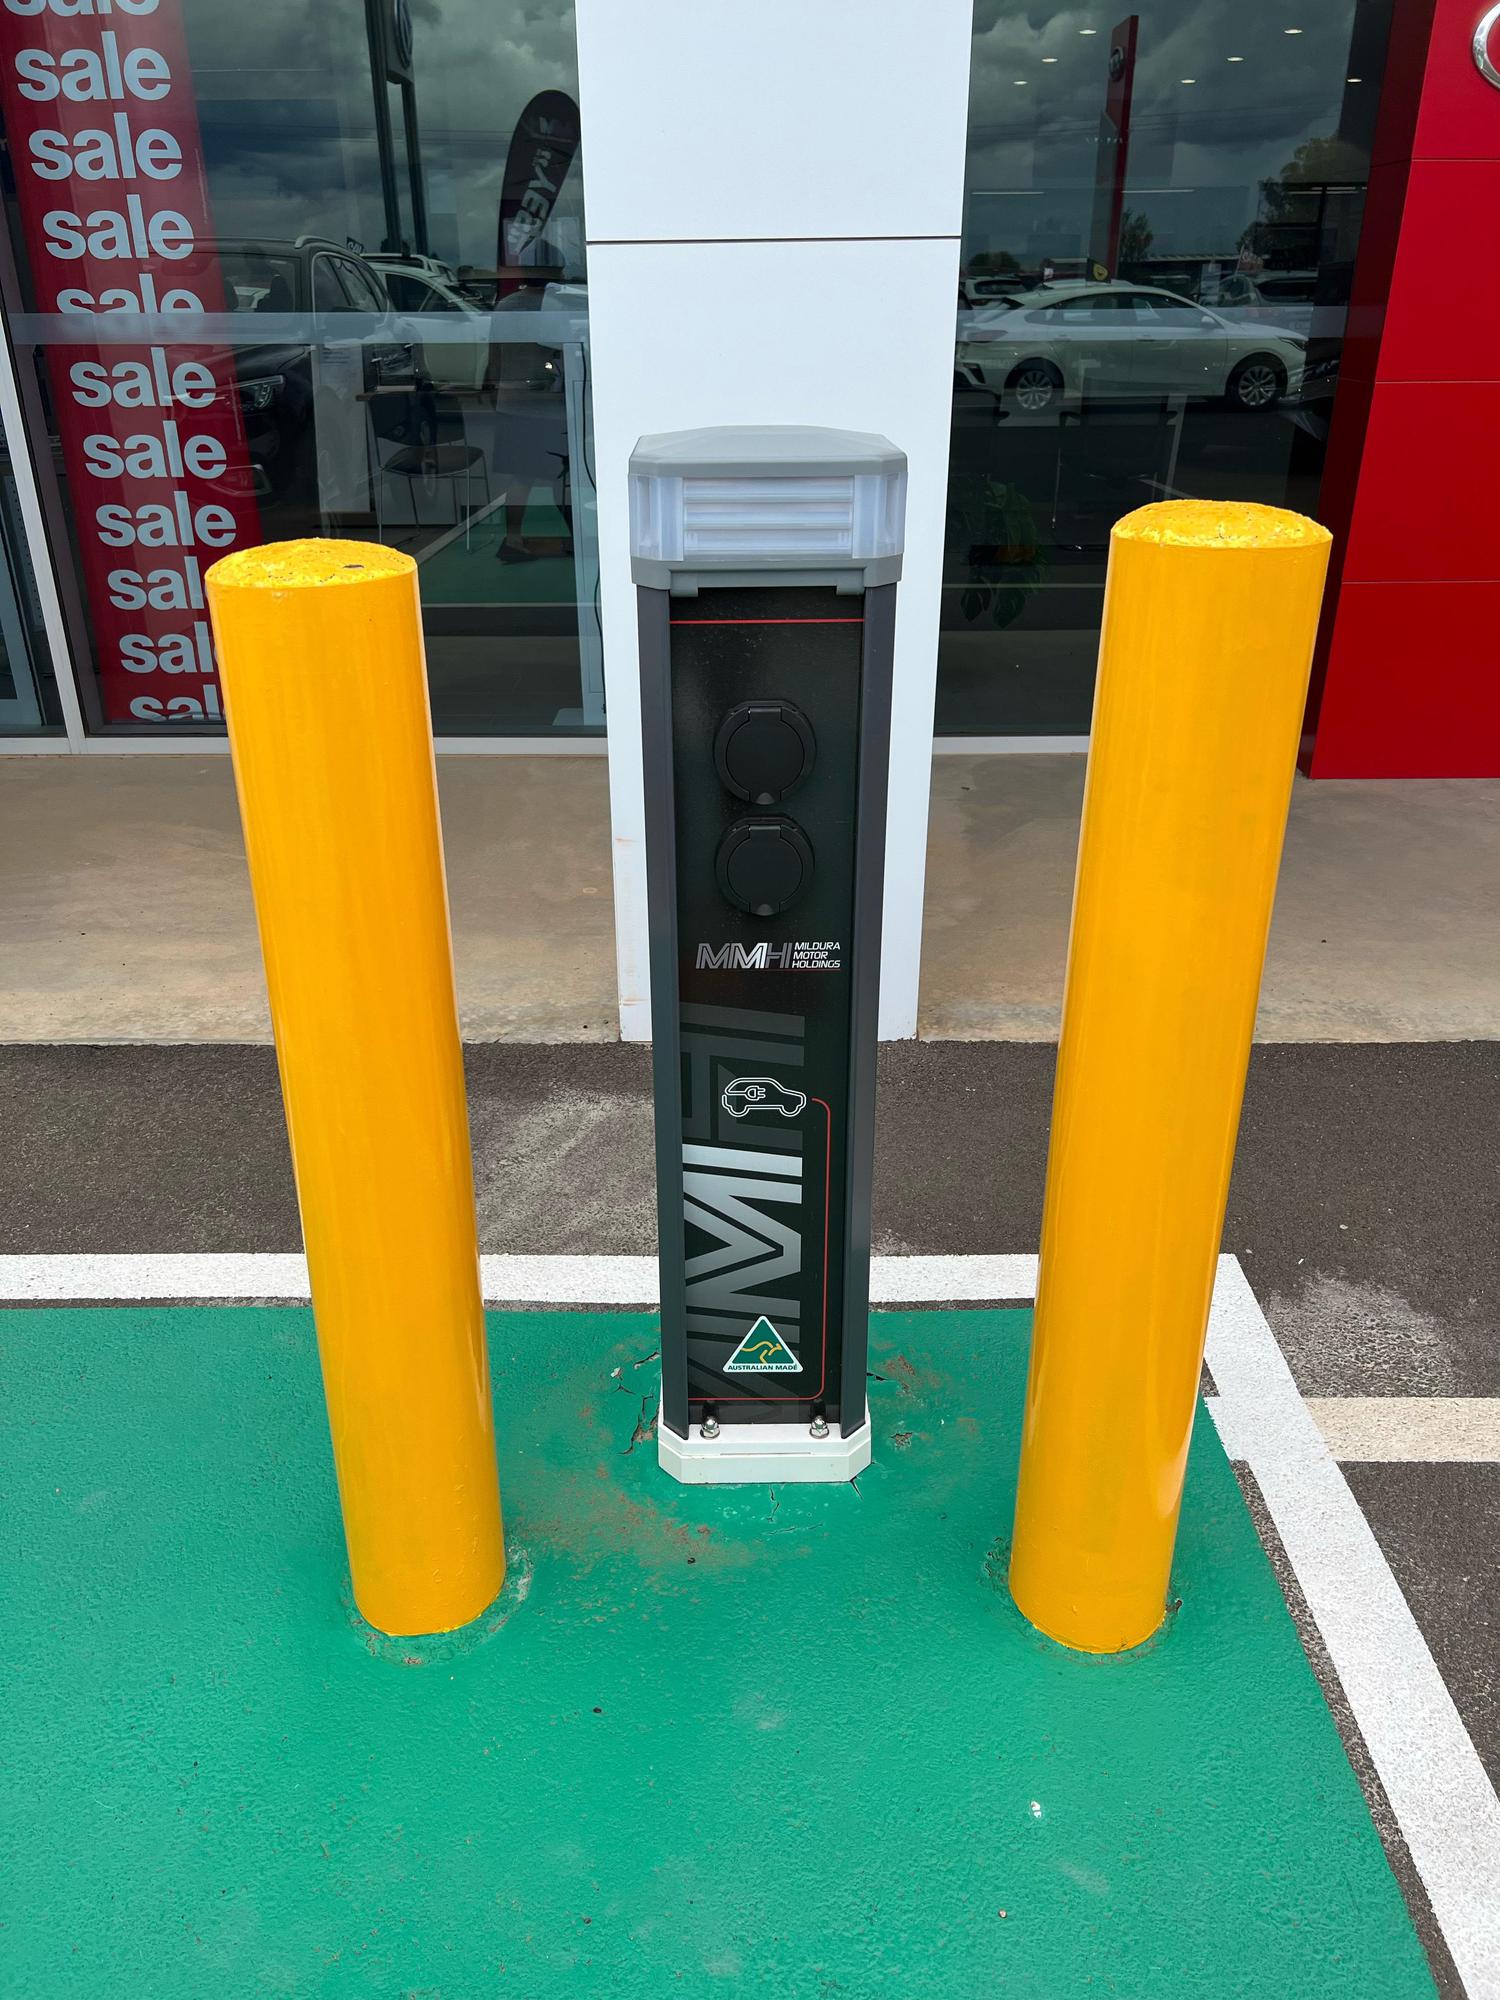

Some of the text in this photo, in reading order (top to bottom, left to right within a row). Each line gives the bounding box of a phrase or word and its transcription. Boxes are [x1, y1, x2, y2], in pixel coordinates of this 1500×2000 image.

[15, 31, 172, 101] sale
[28, 112, 183, 180] sale
[43, 194, 195, 260] sale
[69, 347, 217, 408] sale
[83, 420, 227, 479] sale
[95, 491, 237, 547] sale
[107, 556, 205, 610] sal
[119, 621, 216, 674] sal
[130, 684, 223, 721] sal
[695, 942, 793, 969] MMH
[791, 960, 841, 969] HOLDINGS
[793, 951, 829, 960] MOTOR
[794, 941, 841, 951] MILDURA
